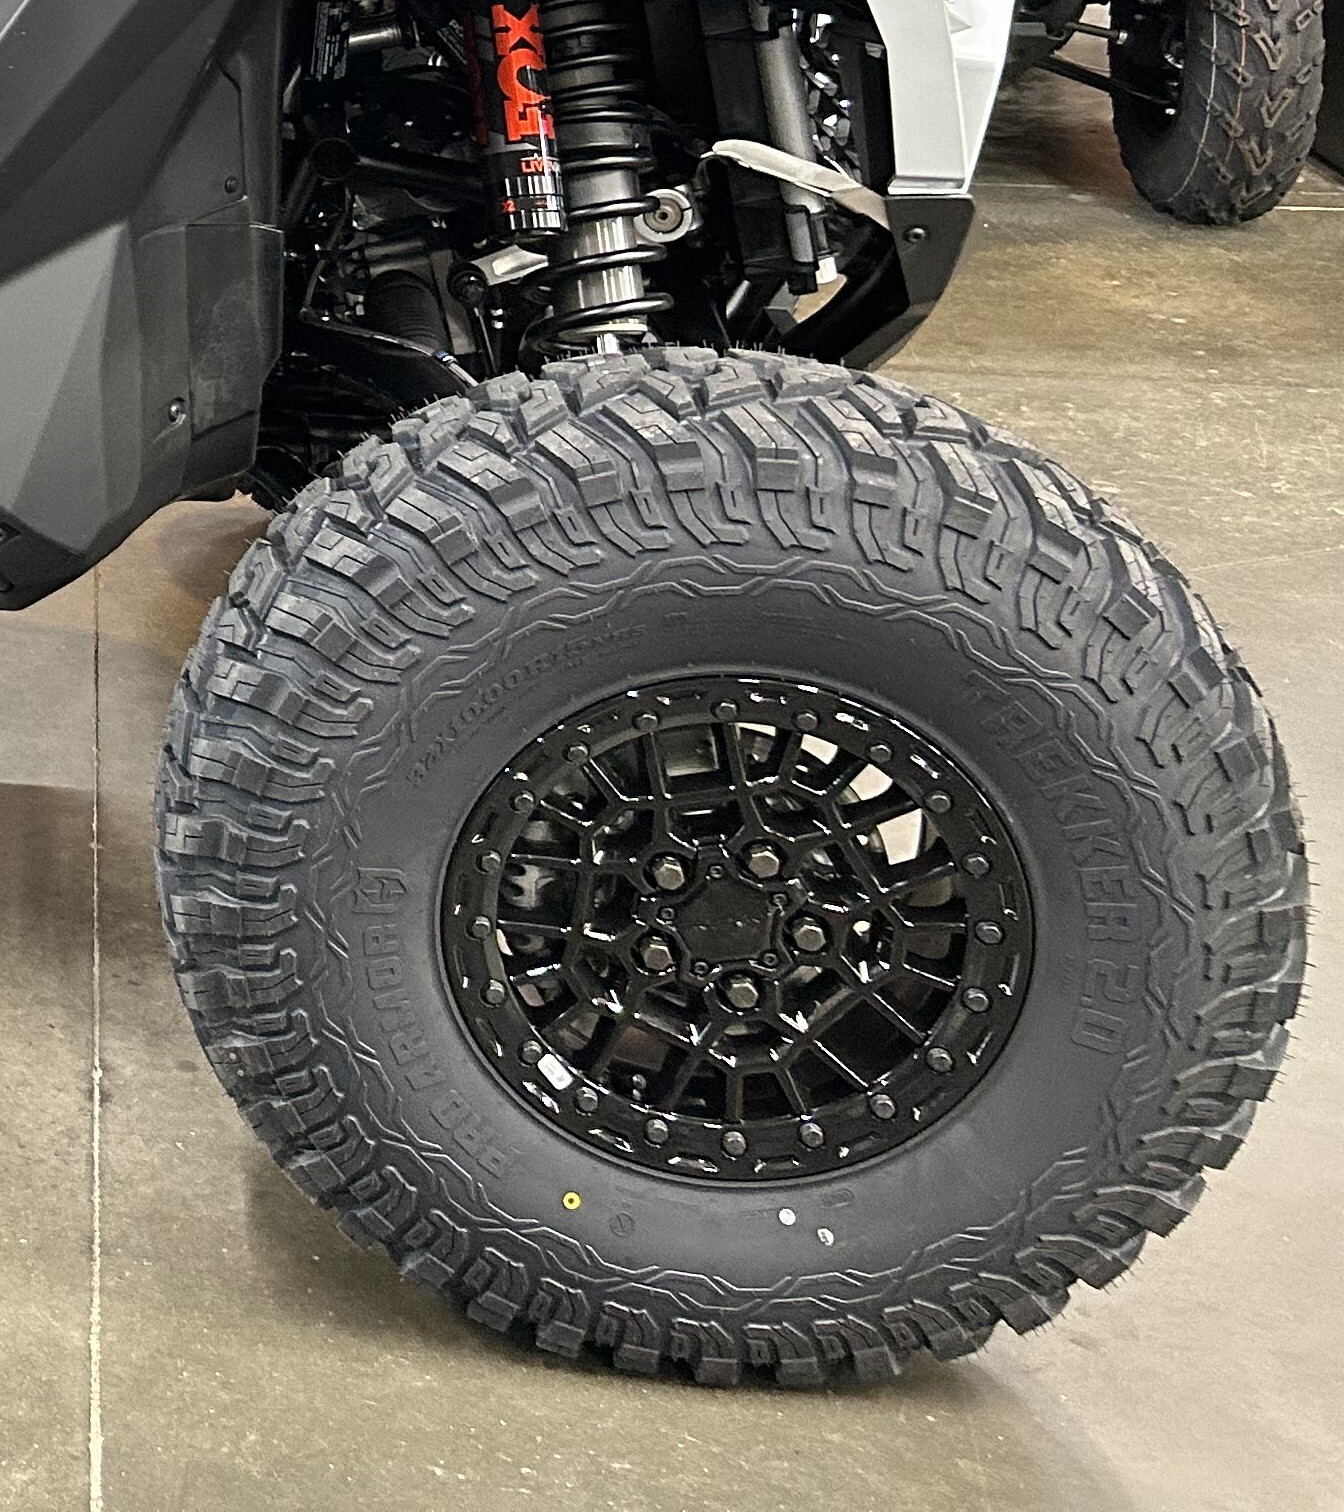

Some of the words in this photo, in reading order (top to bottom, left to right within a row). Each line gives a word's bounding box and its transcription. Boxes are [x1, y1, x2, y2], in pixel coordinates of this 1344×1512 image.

[491, 3, 557, 141] FOX
[965, 669, 1142, 943] TREKKER
[362, 923, 447, 1091] ARMOR
[428, 1090, 514, 1179] PRO
